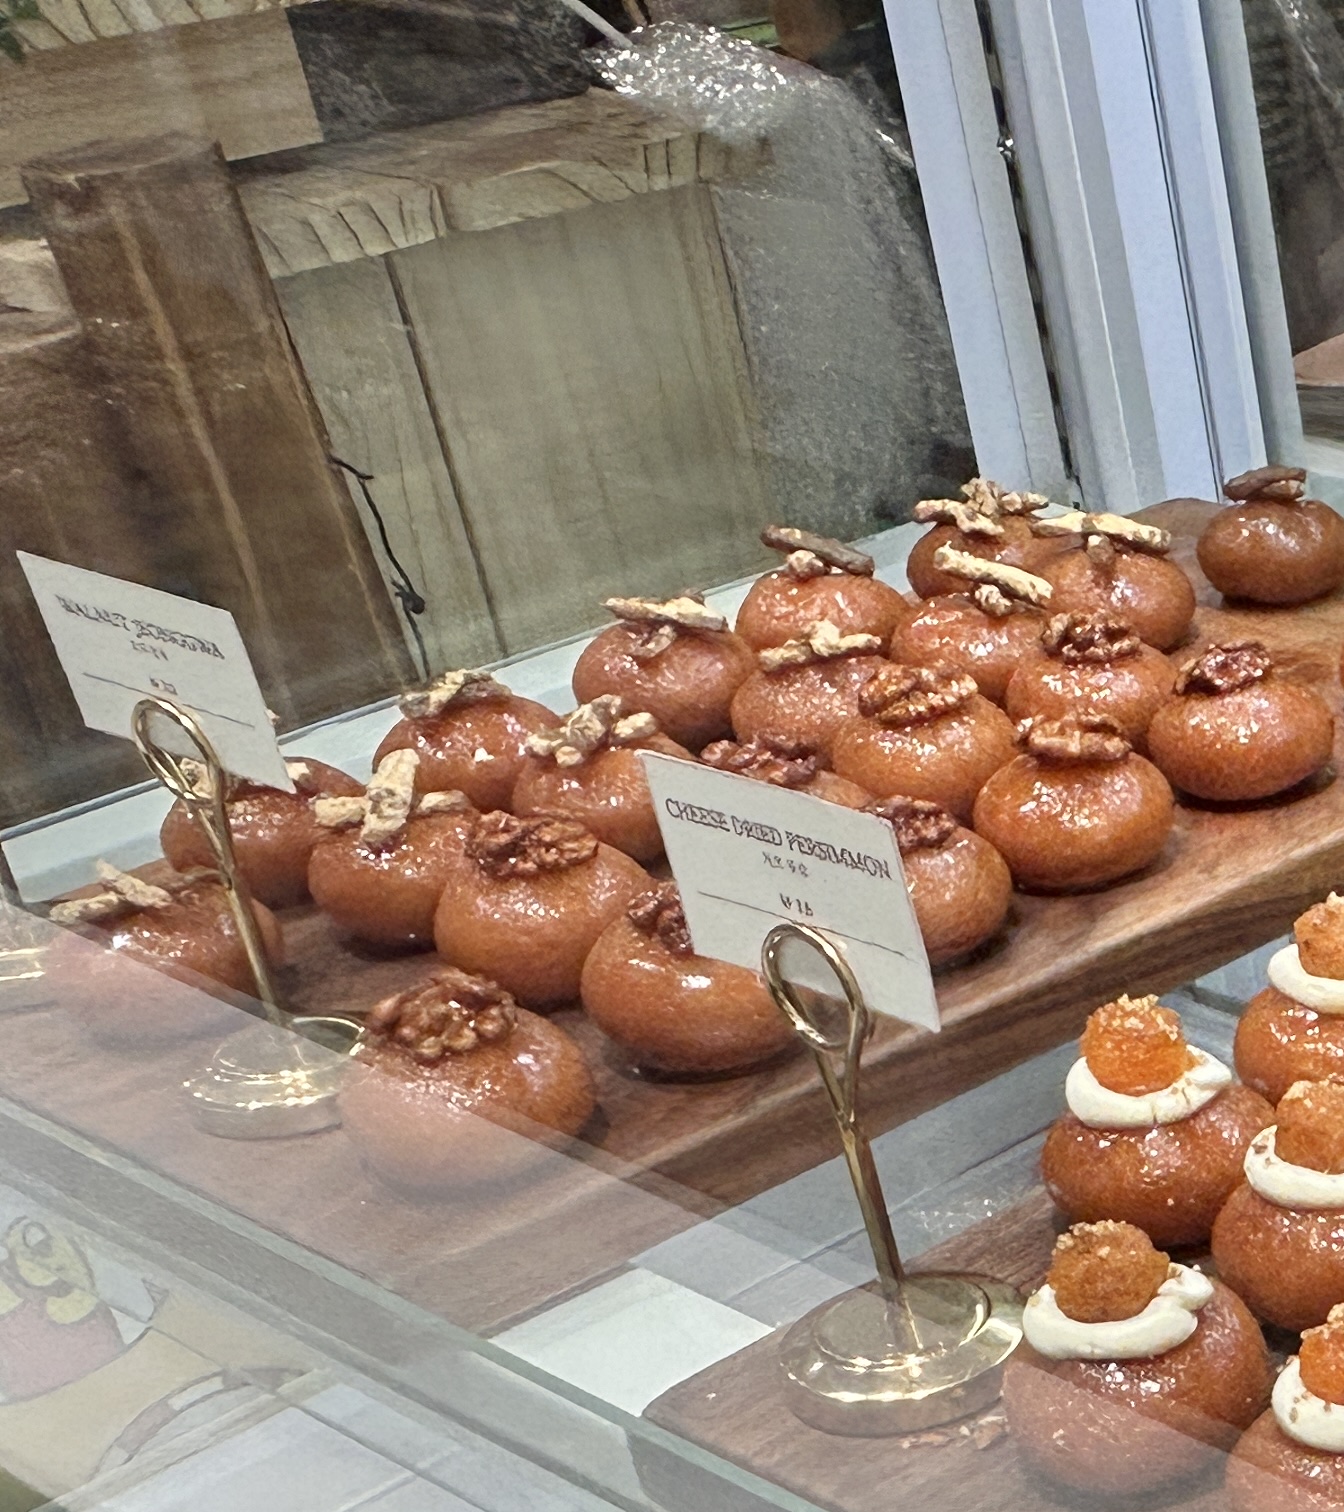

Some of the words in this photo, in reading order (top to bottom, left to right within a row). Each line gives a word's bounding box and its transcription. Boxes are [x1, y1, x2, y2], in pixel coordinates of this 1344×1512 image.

[666, 798, 730, 832] CHEESE
[731, 815, 782, 846] DRIED
[785, 831, 892, 880] PERSIMMON
